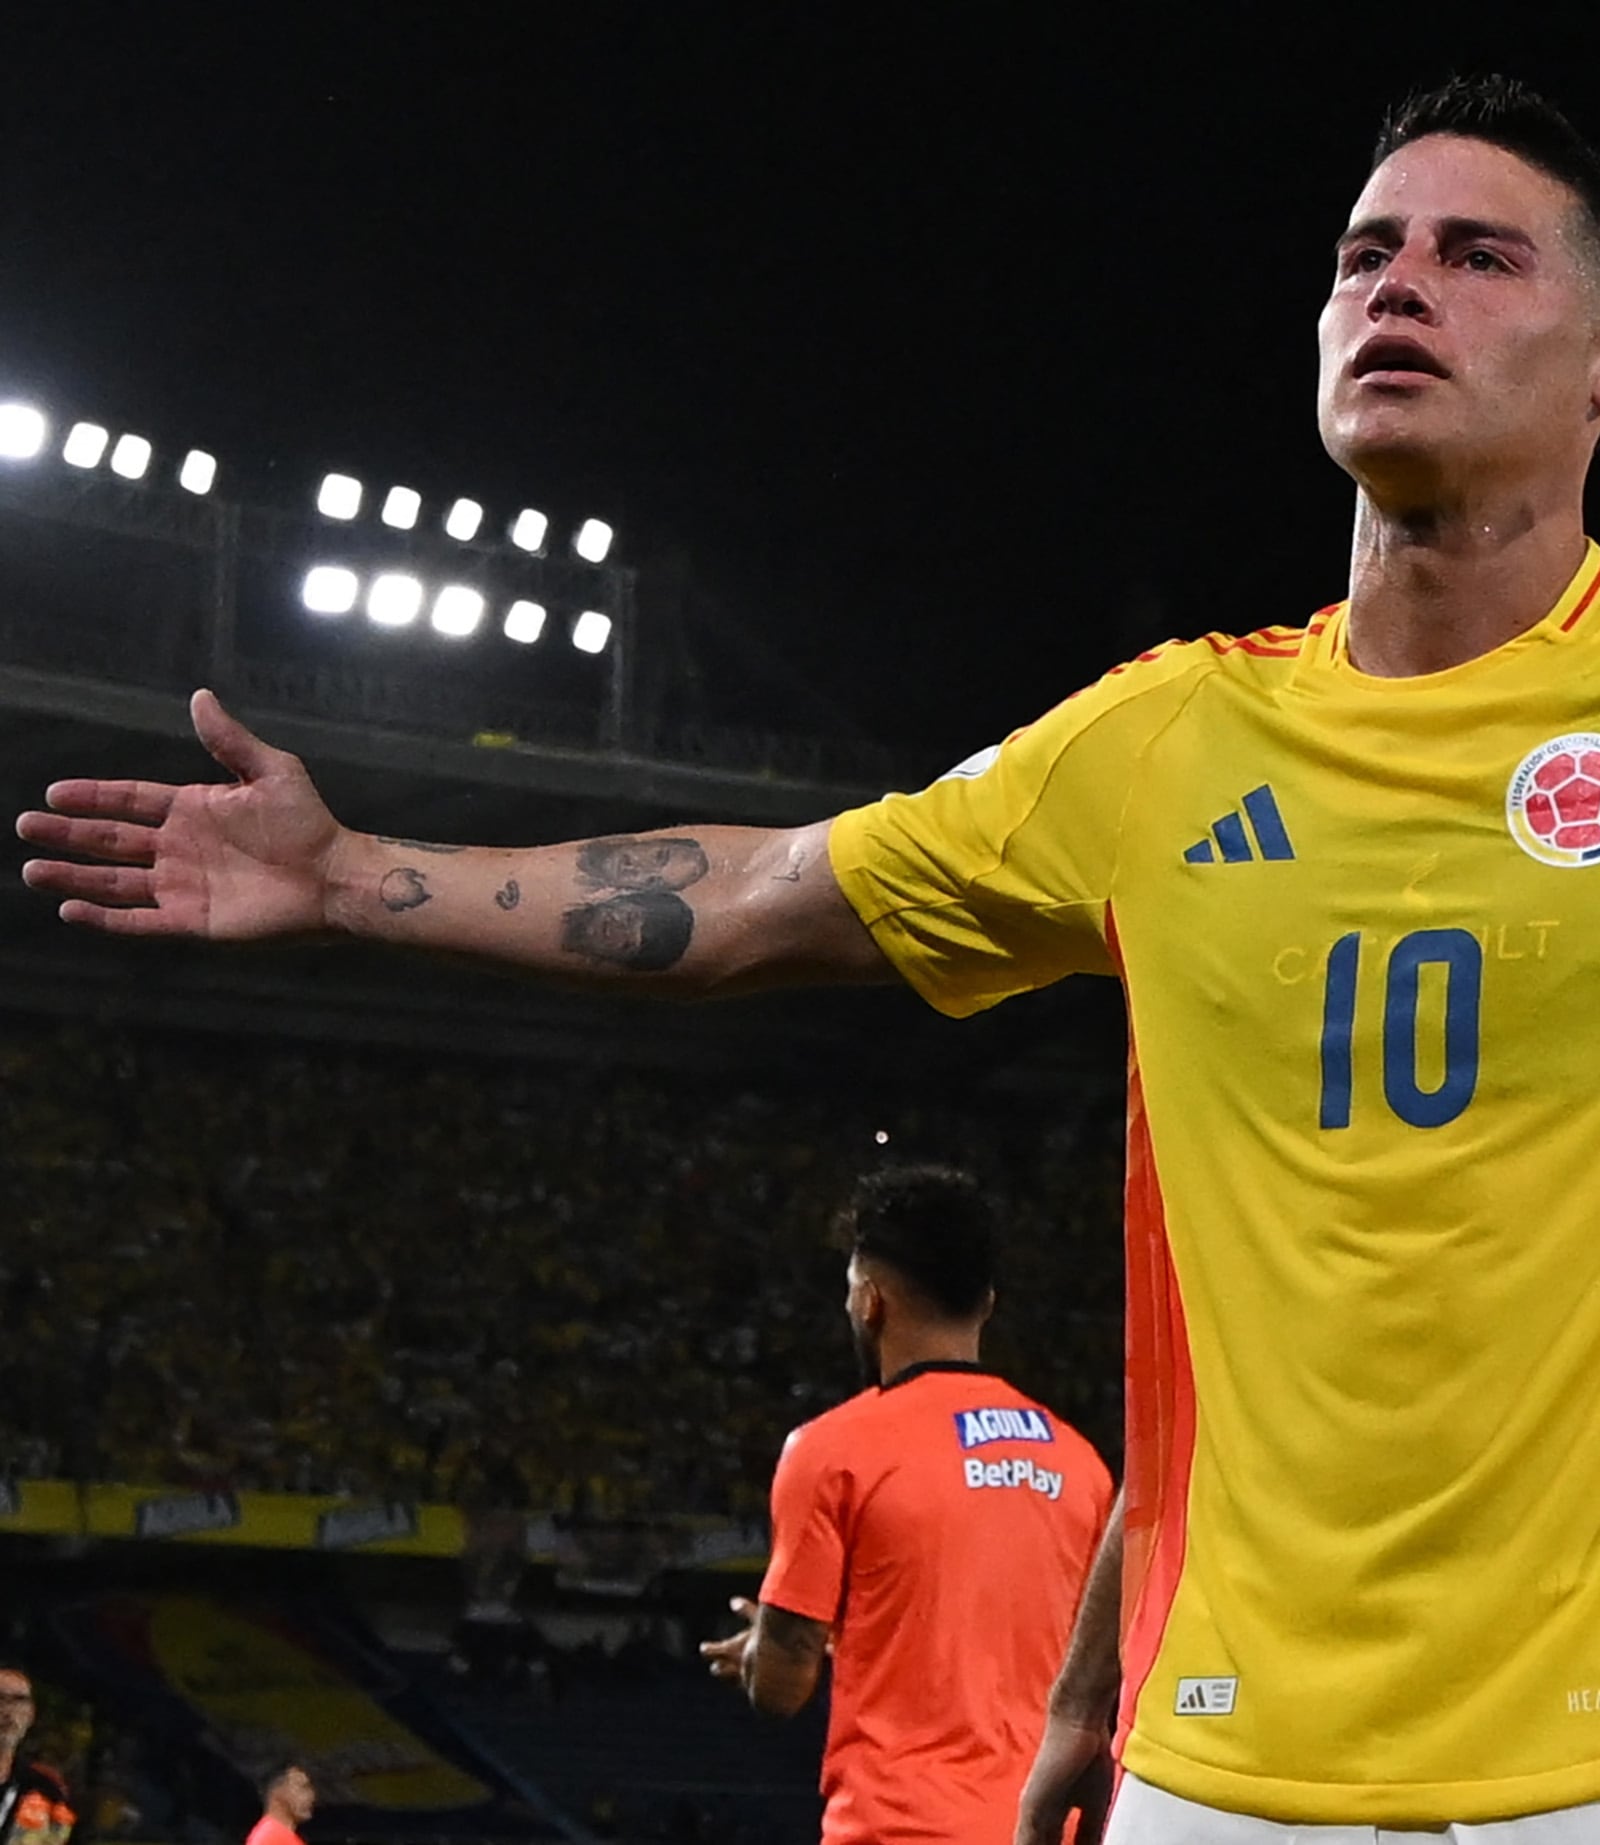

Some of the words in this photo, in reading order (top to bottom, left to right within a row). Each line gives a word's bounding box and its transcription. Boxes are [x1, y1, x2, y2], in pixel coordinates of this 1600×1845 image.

[1318, 928, 1483, 1131] 10
[963, 1408, 1052, 1449] AGUILA
[963, 1458, 1063, 1500] BetPlay
